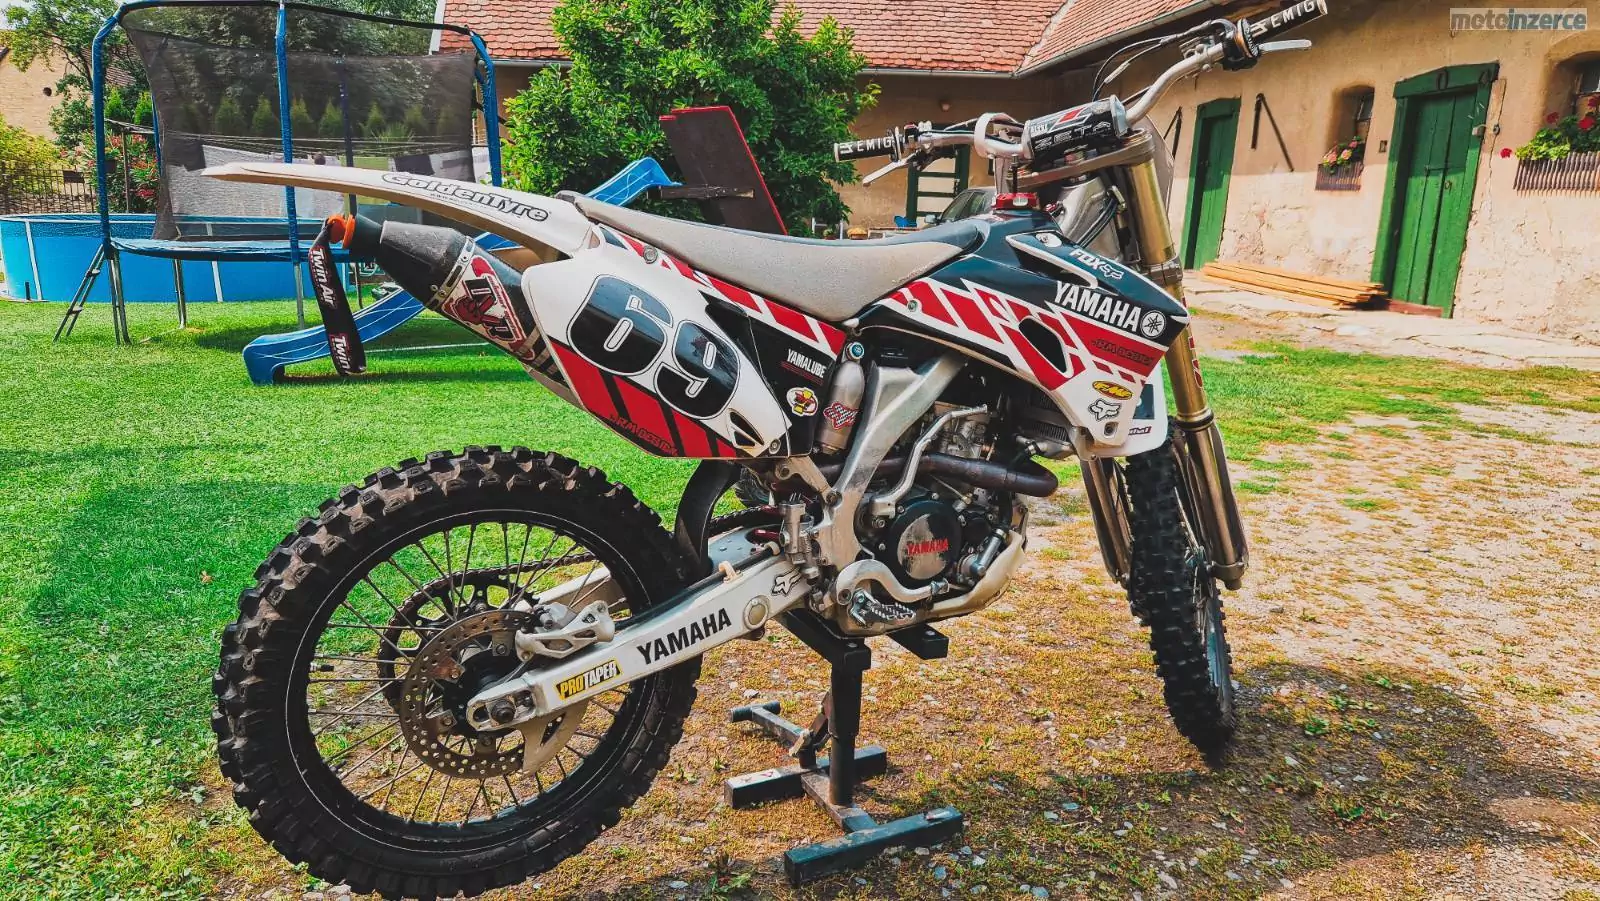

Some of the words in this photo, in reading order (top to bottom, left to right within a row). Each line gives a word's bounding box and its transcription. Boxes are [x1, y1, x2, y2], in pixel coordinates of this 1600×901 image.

[1270, 0, 1315, 28] EMIG
[857, 136, 892, 152] EMIG
[1069, 248, 1106, 270] FOX
[312, 248, 327, 284] Twin
[320, 283, 335, 308] Air
[1054, 280, 1142, 332] YAMAHA
[334, 335, 351, 369] Twin
[566, 274, 741, 421] 69
[787, 348, 827, 378] YAMALUBE
[906, 538, 949, 556] YAMAHA
[636, 607, 732, 665] YAMAHA
